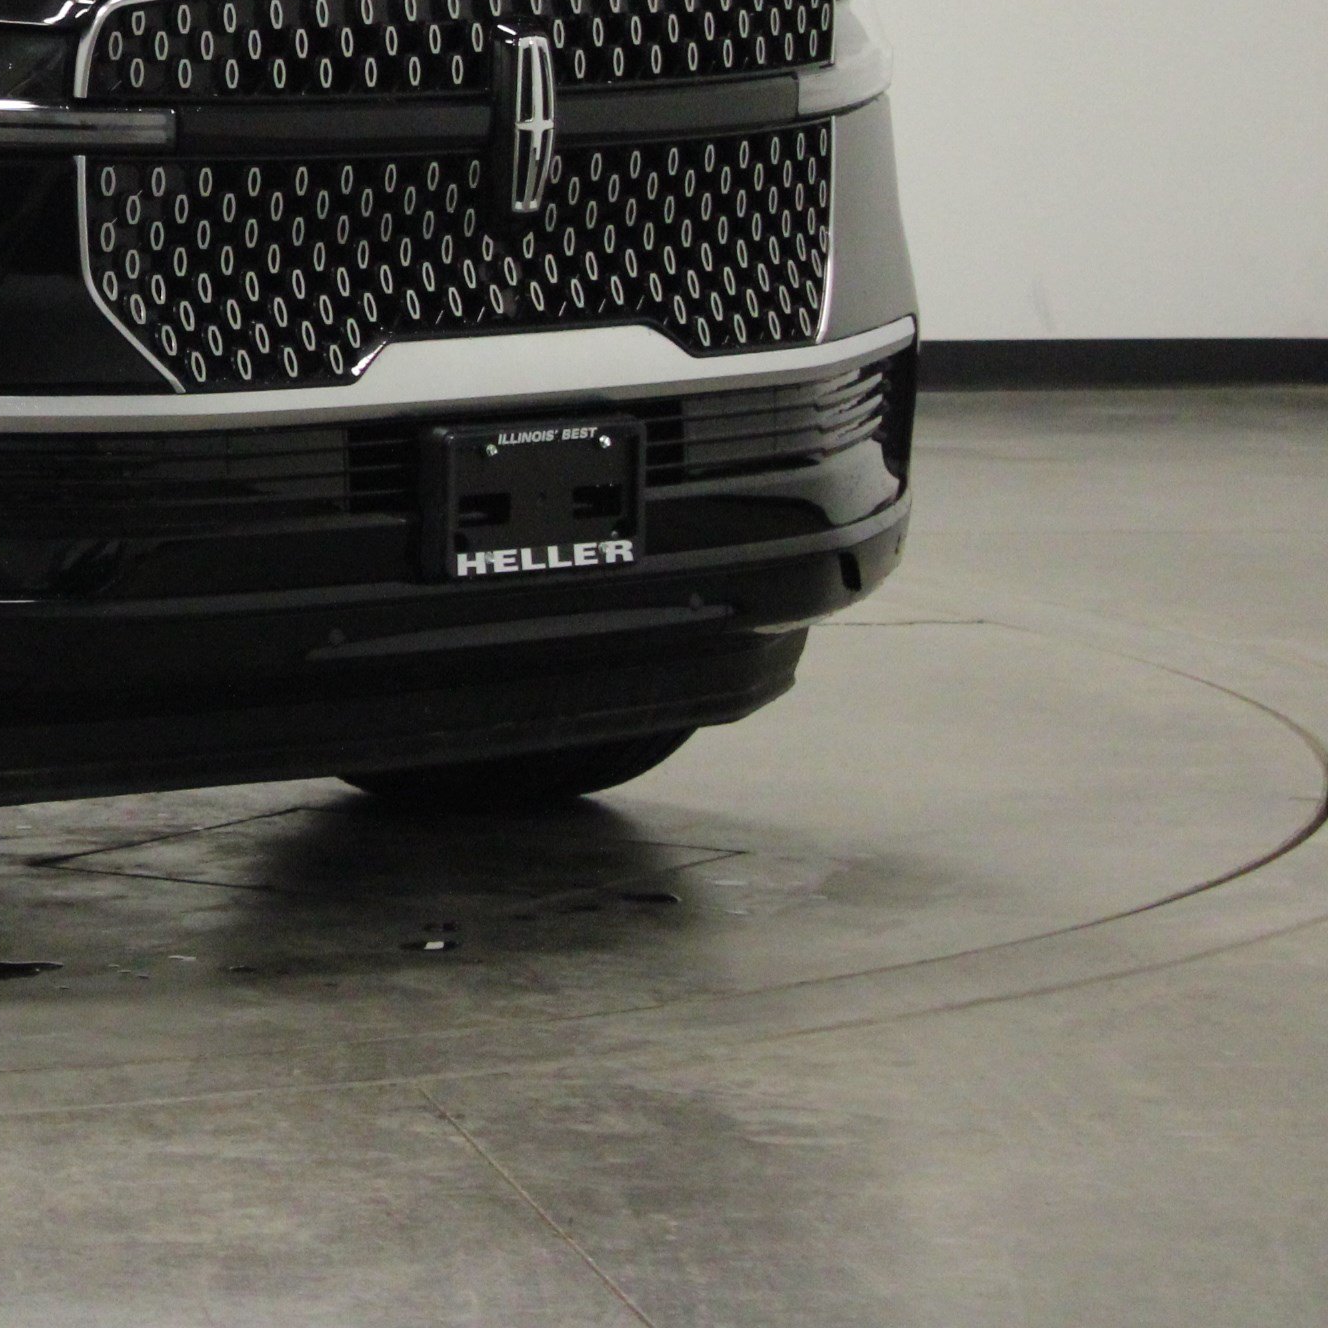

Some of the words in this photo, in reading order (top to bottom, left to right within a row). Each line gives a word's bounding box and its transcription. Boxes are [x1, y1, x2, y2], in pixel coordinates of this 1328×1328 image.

[498, 430, 558, 446] ILLINOIS'
[561, 427, 597, 441] BEST
[456, 539, 634, 577] HELLER
